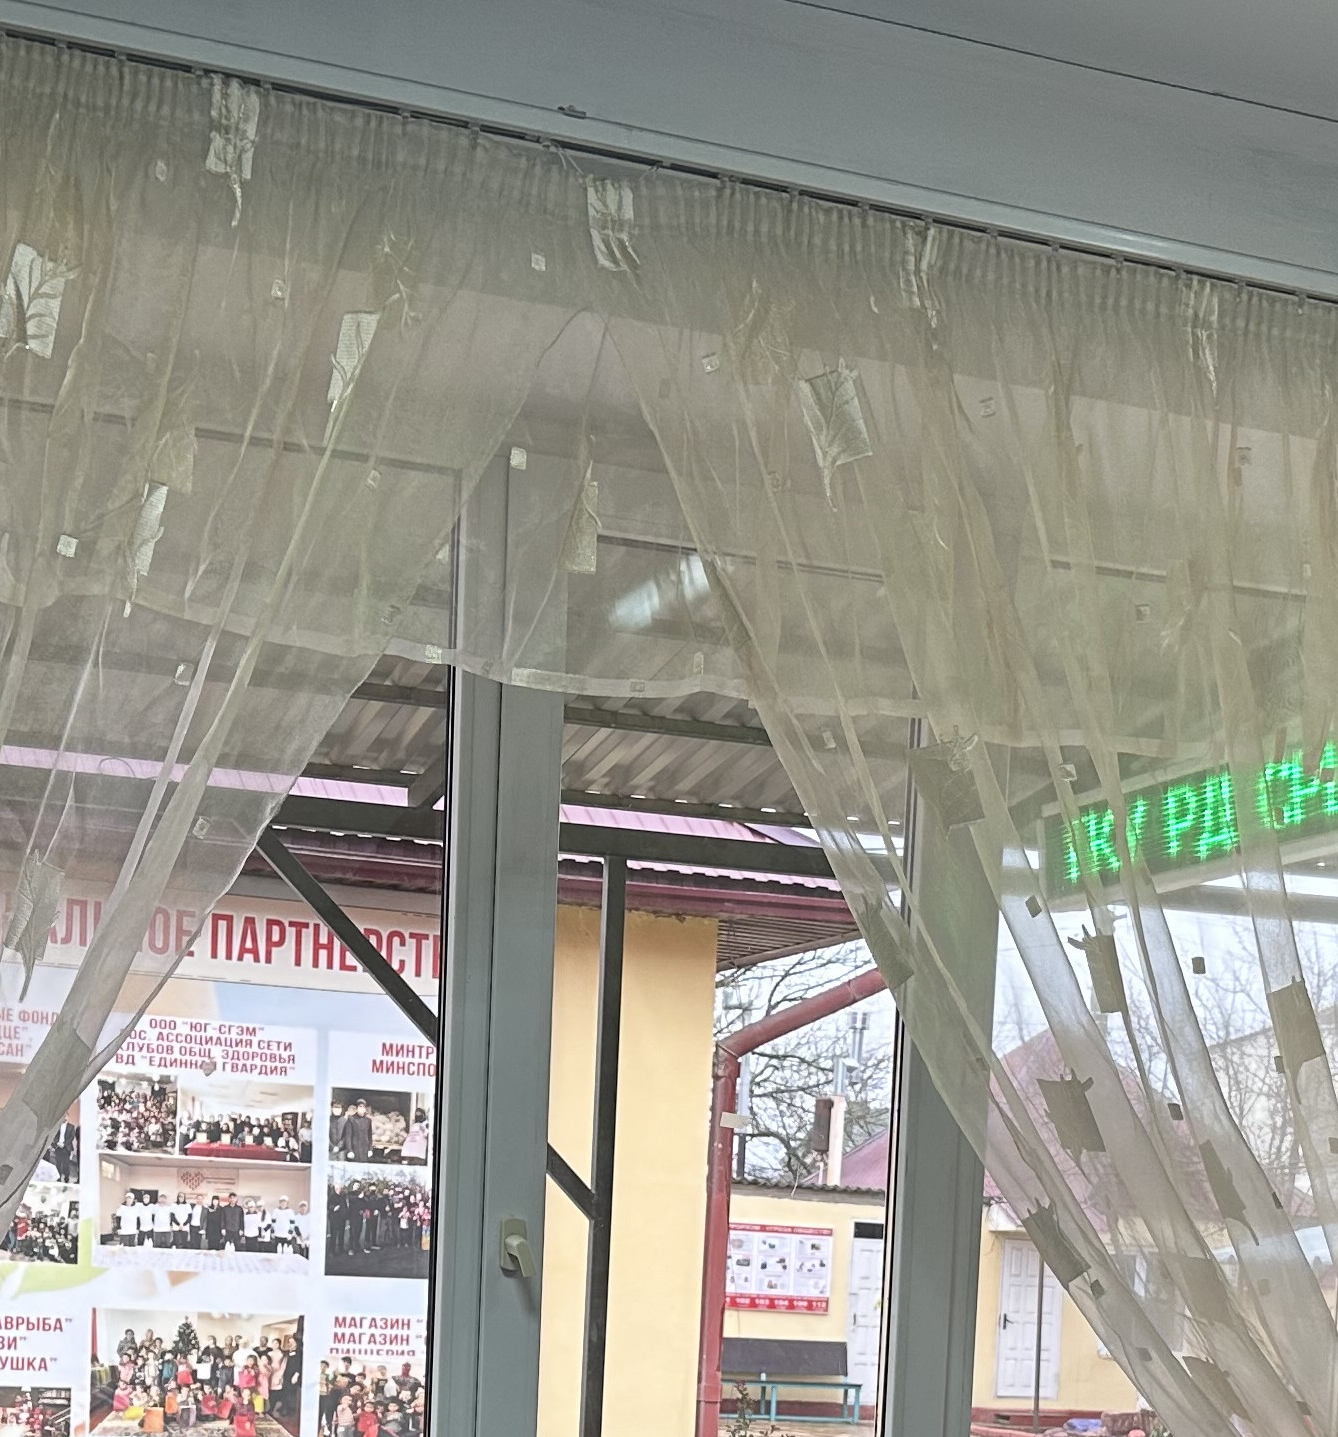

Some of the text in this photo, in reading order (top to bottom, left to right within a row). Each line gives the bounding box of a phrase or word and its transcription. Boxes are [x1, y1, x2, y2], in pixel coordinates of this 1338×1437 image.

[149, 1018, 177, 1031] ООО
[156, 1031, 253, 1048] АССОЦИАЦИЯ
[257, 1040, 293, 1052] СЕТИ
[221, 1049, 296, 1065] ЗДОРОВЬЯ
[334, 1315, 411, 1331] МАГАЗИН
[333, 1331, 410, 1347] МАГАЗИН
